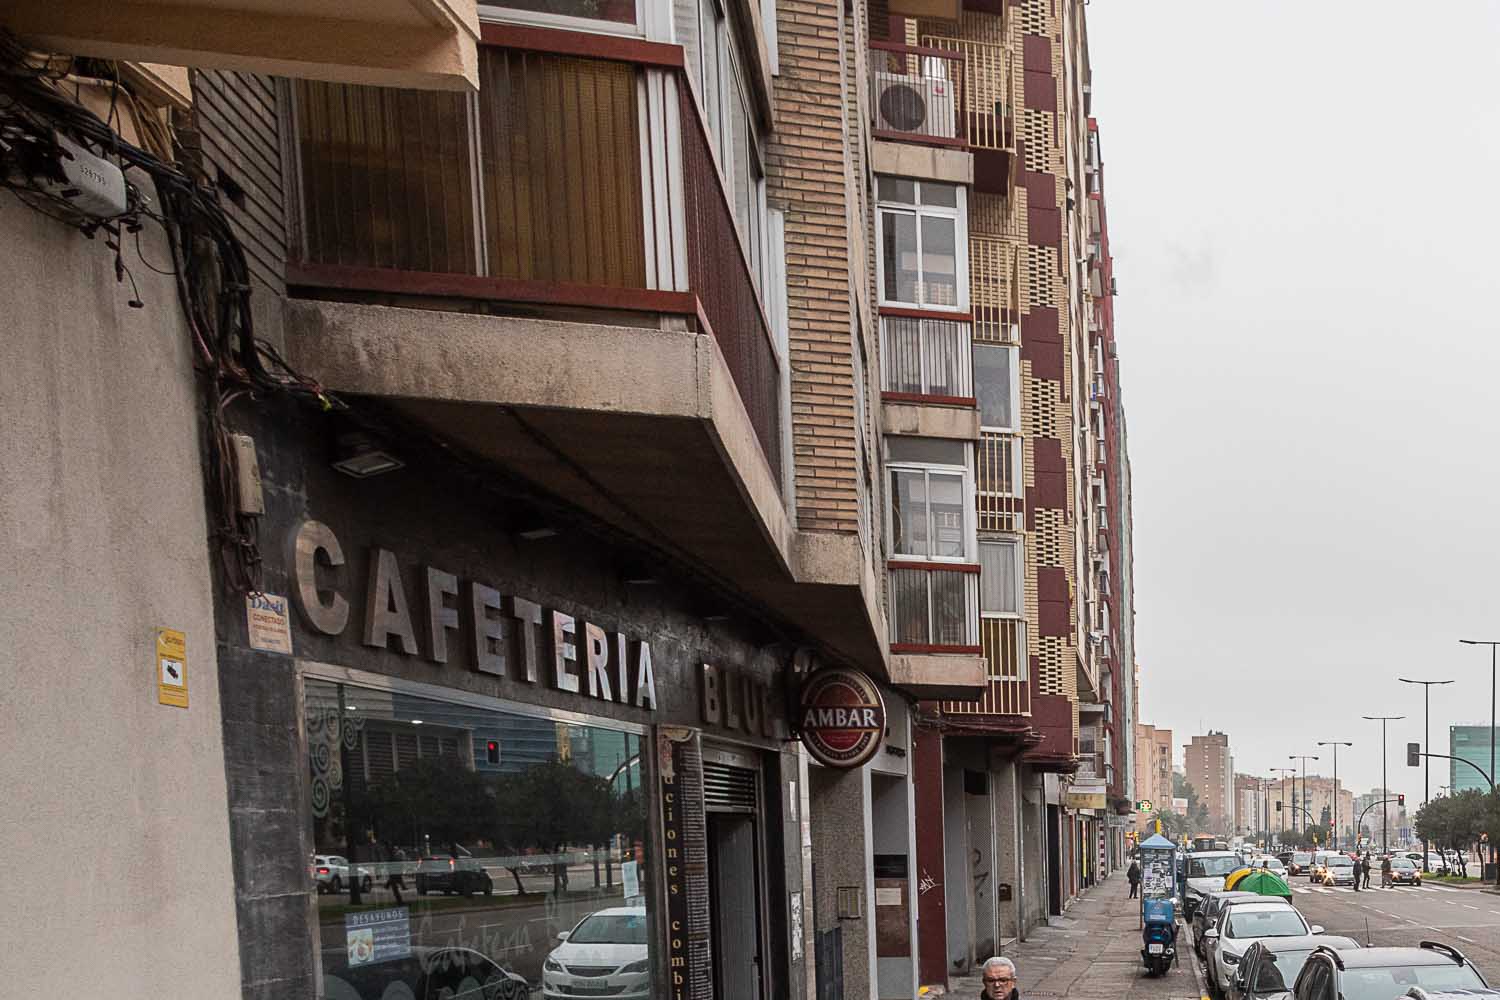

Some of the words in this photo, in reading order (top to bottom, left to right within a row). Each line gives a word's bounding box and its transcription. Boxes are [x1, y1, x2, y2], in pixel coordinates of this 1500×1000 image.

[293, 519, 657, 710] CAFETERIA
[803, 708, 880, 728] AMBAR
[663, 775, 678, 894] aciones
[352, 910, 403, 926] DESAYUNOS
